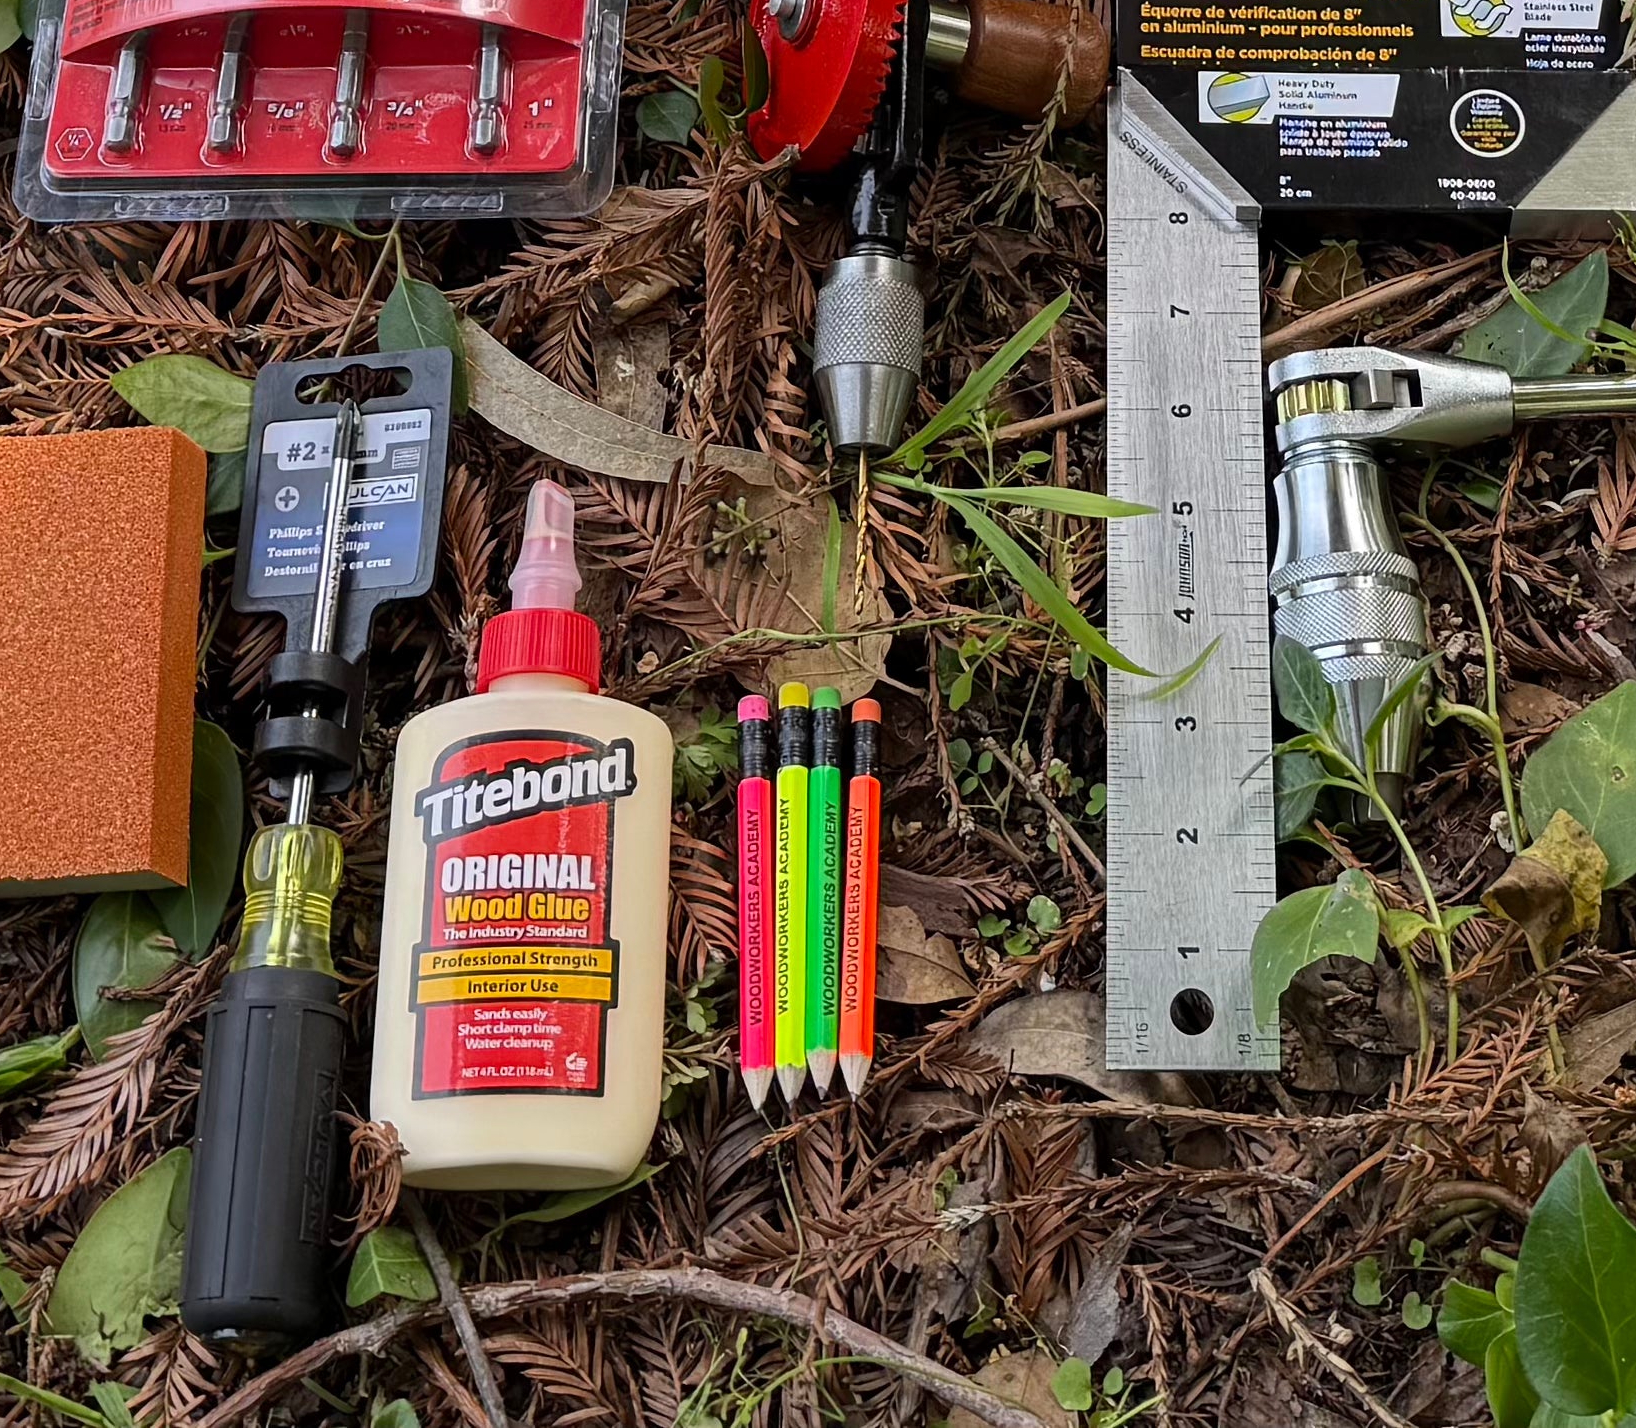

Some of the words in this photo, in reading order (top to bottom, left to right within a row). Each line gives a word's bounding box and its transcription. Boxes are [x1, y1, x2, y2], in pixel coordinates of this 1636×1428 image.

[1140, 2, 1205, 21] Équerre
[1208, 6, 1226, 19] de
[1229, 5, 1322, 21] vérification
[1325, 8, 1342, 21] de
[1140, 24, 1156, 35] en
[1160, 21, 1244, 36] aluminium
[1260, 26, 1297, 39] pour
[1301, 22, 1413, 39] professionnels
[1140, 45, 1211, 61] Escuadra
[1215, 46, 1235, 60] de
[1239, 45, 1352, 64] comprobación
[1356, 48, 1375, 61] de
[1119, 131, 1189, 195] STAINLESS
[1169, 212, 1189, 225] 8
[1170, 305, 1190, 318] 7
[1171, 404, 1192, 418] 6
[287, 442, 316, 462] #2
[1173, 501, 1193, 515] 5
[269, 527, 312, 539] Phillips
[367, 557, 391, 567] cruz
[1173, 607, 1194, 623] 4
[1175, 716, 1197, 732] 3
[423, 748, 627, 837] Titebond
[779, 798, 790, 874] ACADEMY
[824, 801, 837, 880] ACADEMY
[849, 806, 863, 880] ACADEMY
[1177, 828, 1198, 844] 2
[749, 809, 760, 888] ACADEMY
[442, 854, 595, 892] ORIGINAL
[444, 893, 523, 923] Wood
[527, 893, 590, 920] Glue
[443, 929, 467, 940] The
[469, 925, 525, 940] Industry
[526, 925, 587, 938] Standard
[778, 879, 790, 1016] WOODWORKERS
[823, 883, 836, 1016] WOODWORKERS
[845, 885, 860, 1013] WOODWORKERS
[433, 952, 525, 969] Professional
[529, 952, 597, 969] Strength
[749, 890, 762, 1026] WOODWORKERS
[468, 979, 527, 994] Interior
[531, 981, 558, 992] Use
[474, 1009, 511, 1020] Sands
[513, 1008, 548, 1021] easily
[458, 1024, 491, 1036] Short
[494, 1024, 531, 1036] clamp
[533, 1024, 561, 1034] time
[465, 1038, 501, 1050] Water
[503, 1038, 554, 1050] cleanup
